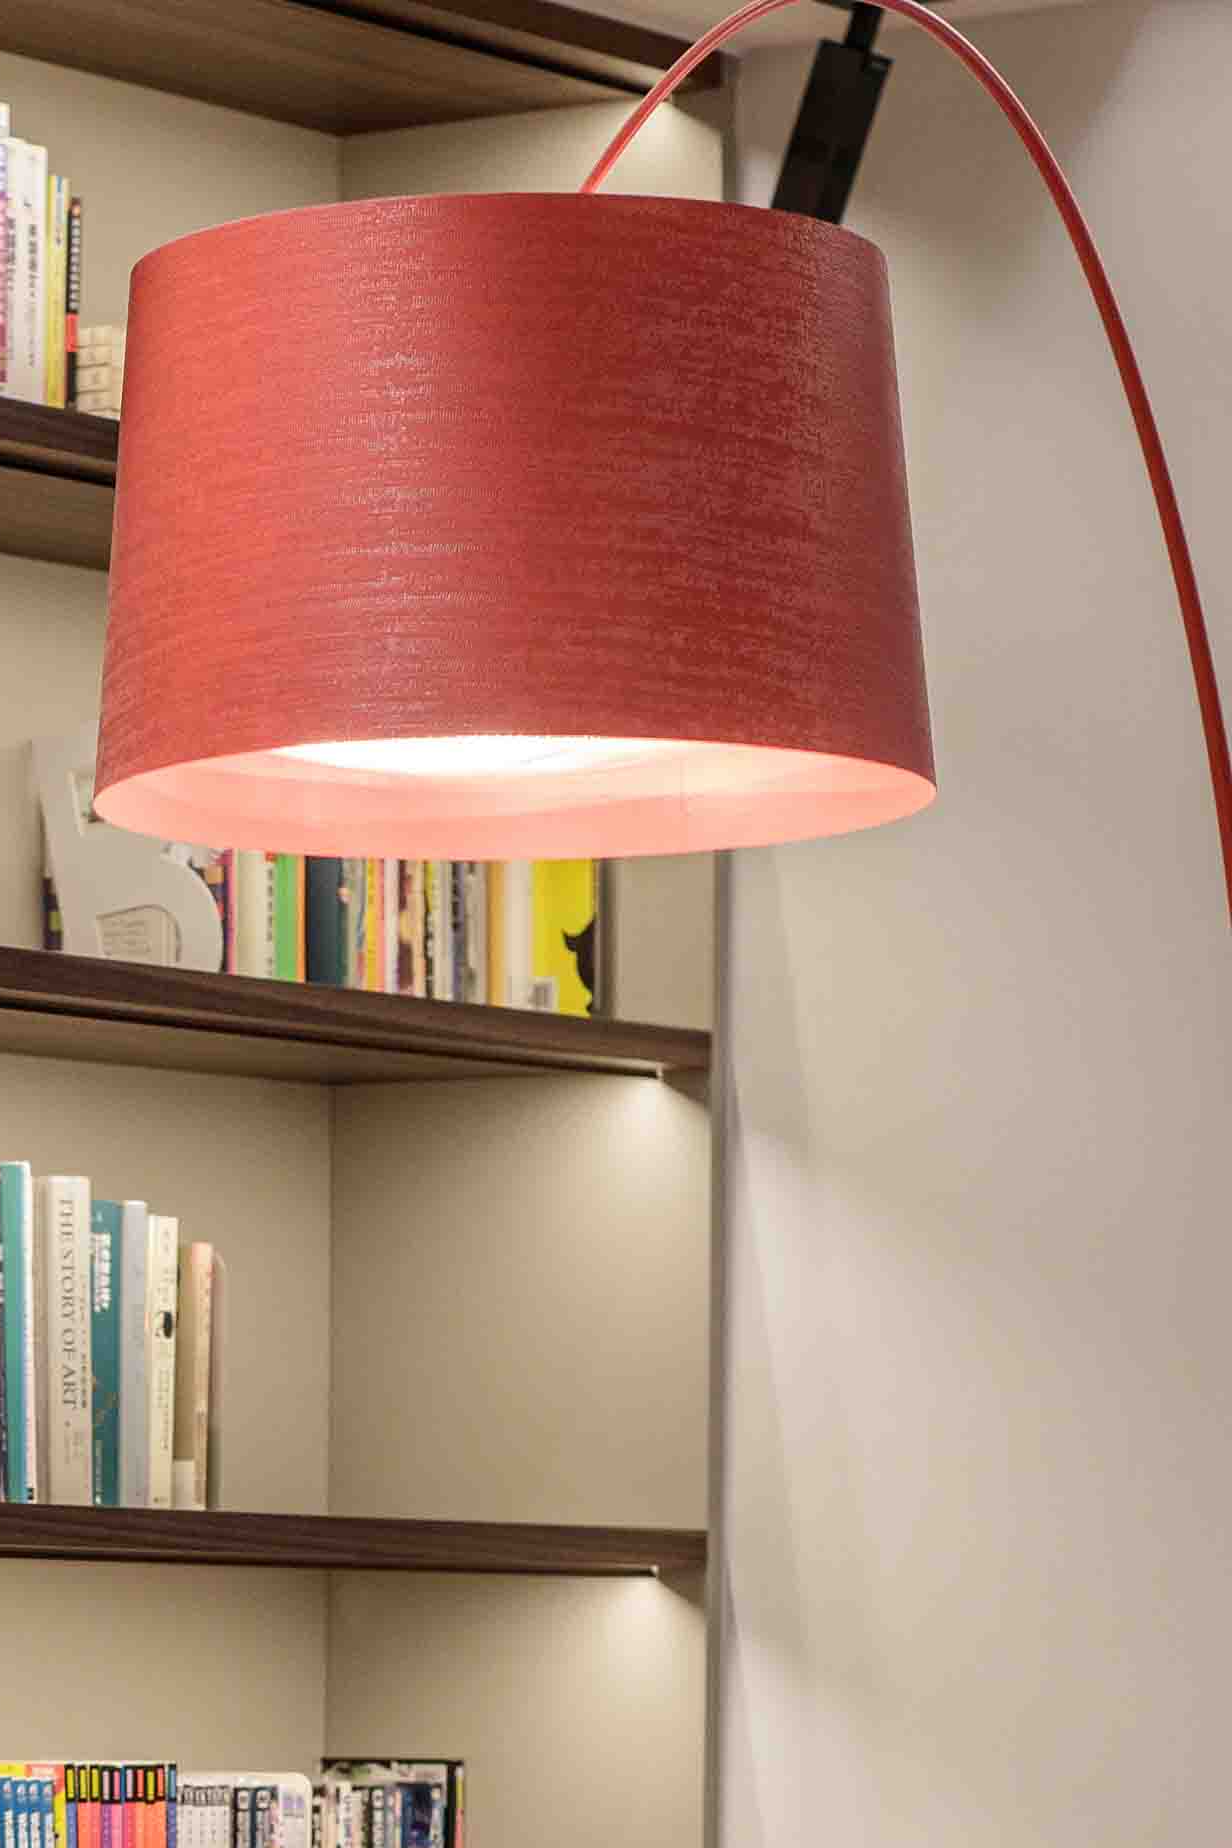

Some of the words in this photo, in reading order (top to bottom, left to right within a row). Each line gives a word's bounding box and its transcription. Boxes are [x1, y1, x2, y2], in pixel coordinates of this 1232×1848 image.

[60, 1200, 73, 1239] THE
[61, 1250, 77, 1321] STORY
[62, 1326, 77, 1362] OF
[63, 1364, 78, 1410] ART
